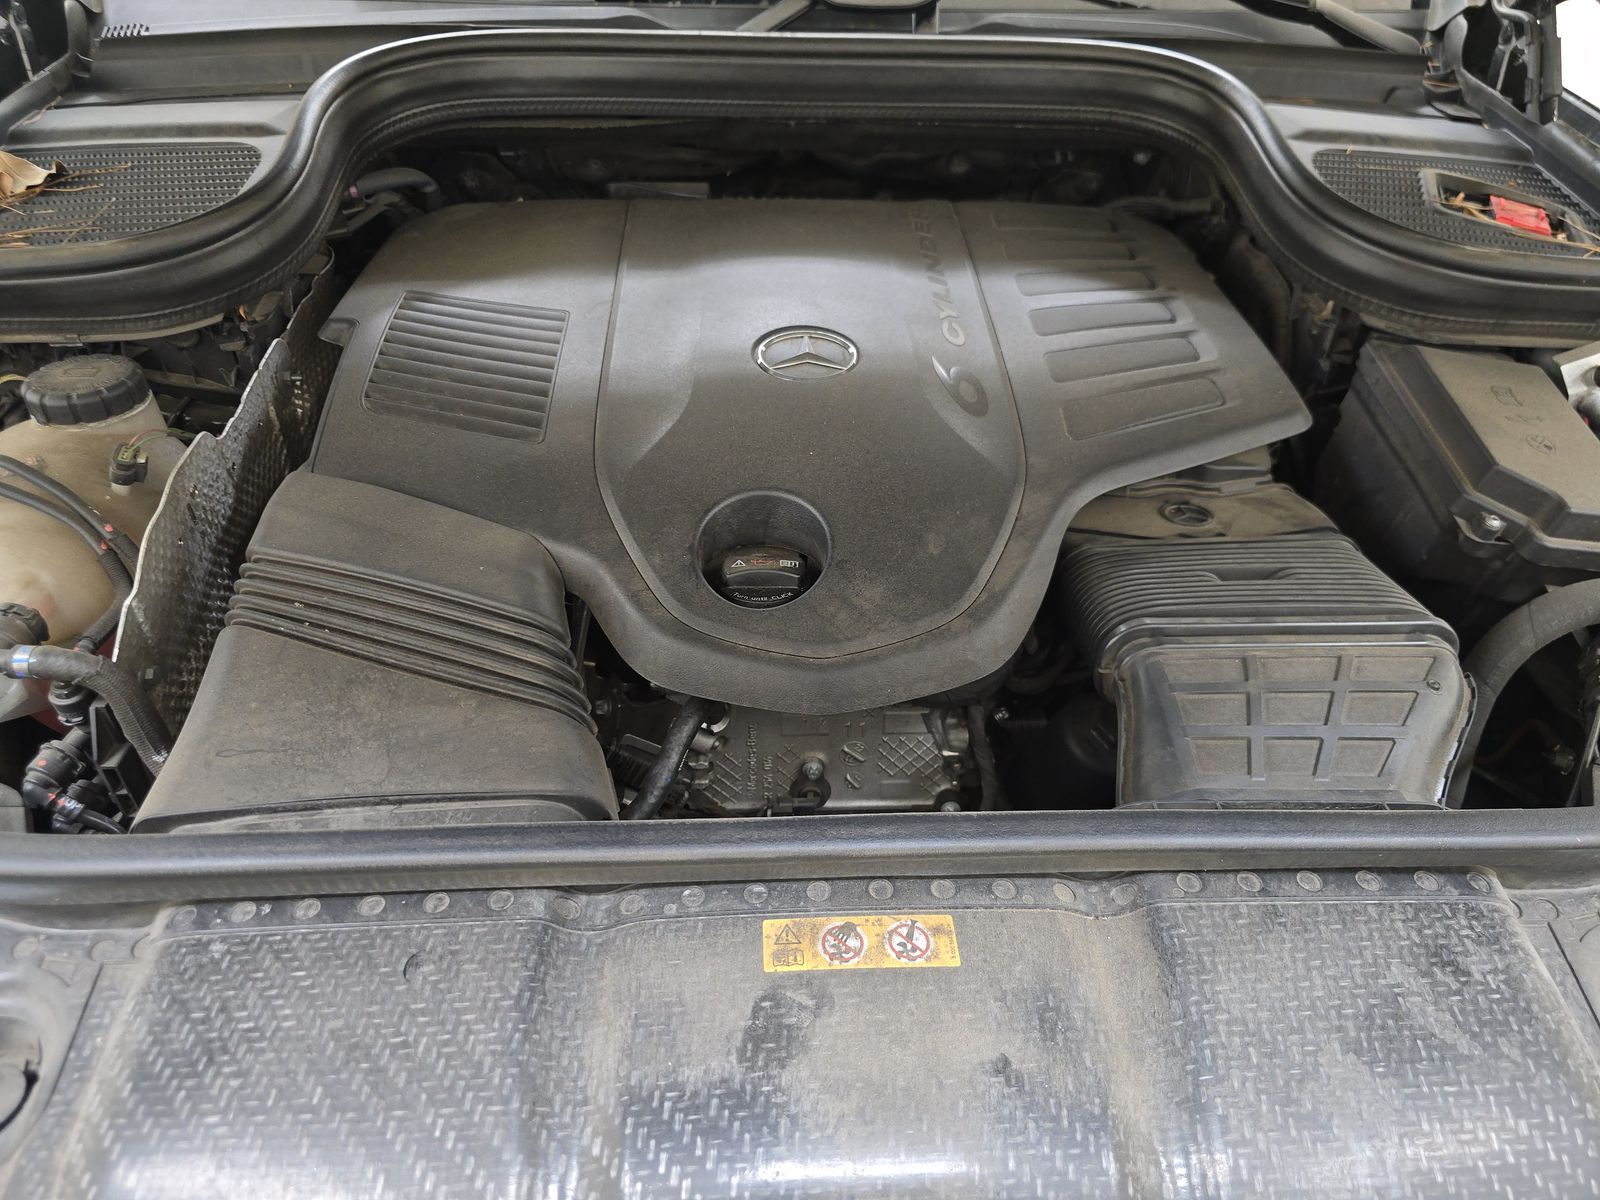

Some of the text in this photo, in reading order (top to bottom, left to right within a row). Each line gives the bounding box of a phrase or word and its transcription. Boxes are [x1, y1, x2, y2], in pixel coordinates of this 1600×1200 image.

[909, 208, 989, 417] 6 CYLINDER
[733, 592, 749, 600] Turn
[771, 592, 794, 600] CLICK
